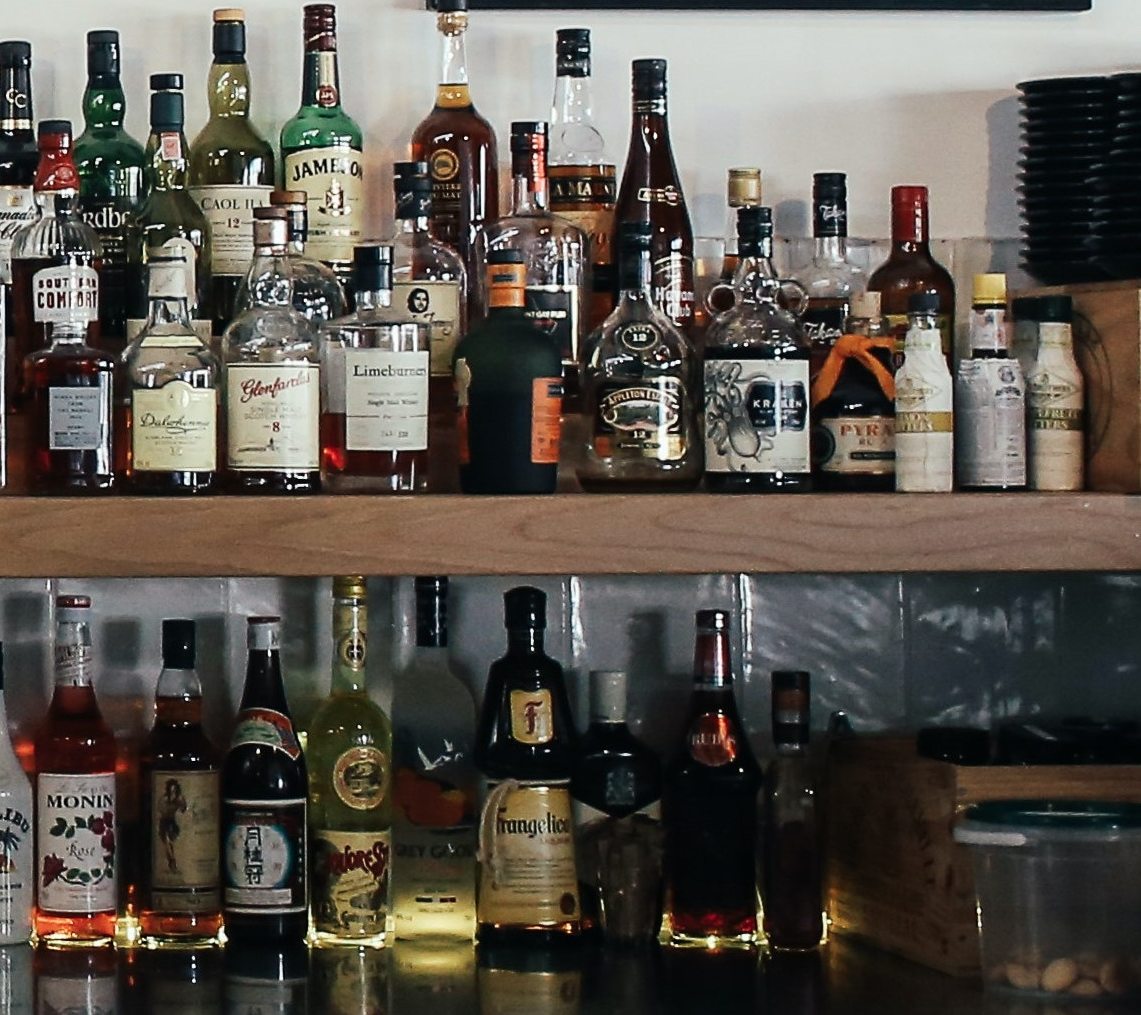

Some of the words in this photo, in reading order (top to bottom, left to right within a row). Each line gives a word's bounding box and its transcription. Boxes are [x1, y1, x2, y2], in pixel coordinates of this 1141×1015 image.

[201, 197, 241, 211] CAOL
[226, 217, 241, 229] 12
[271, 421, 281, 432] 8
[46, 794, 114, 809] MONIN
